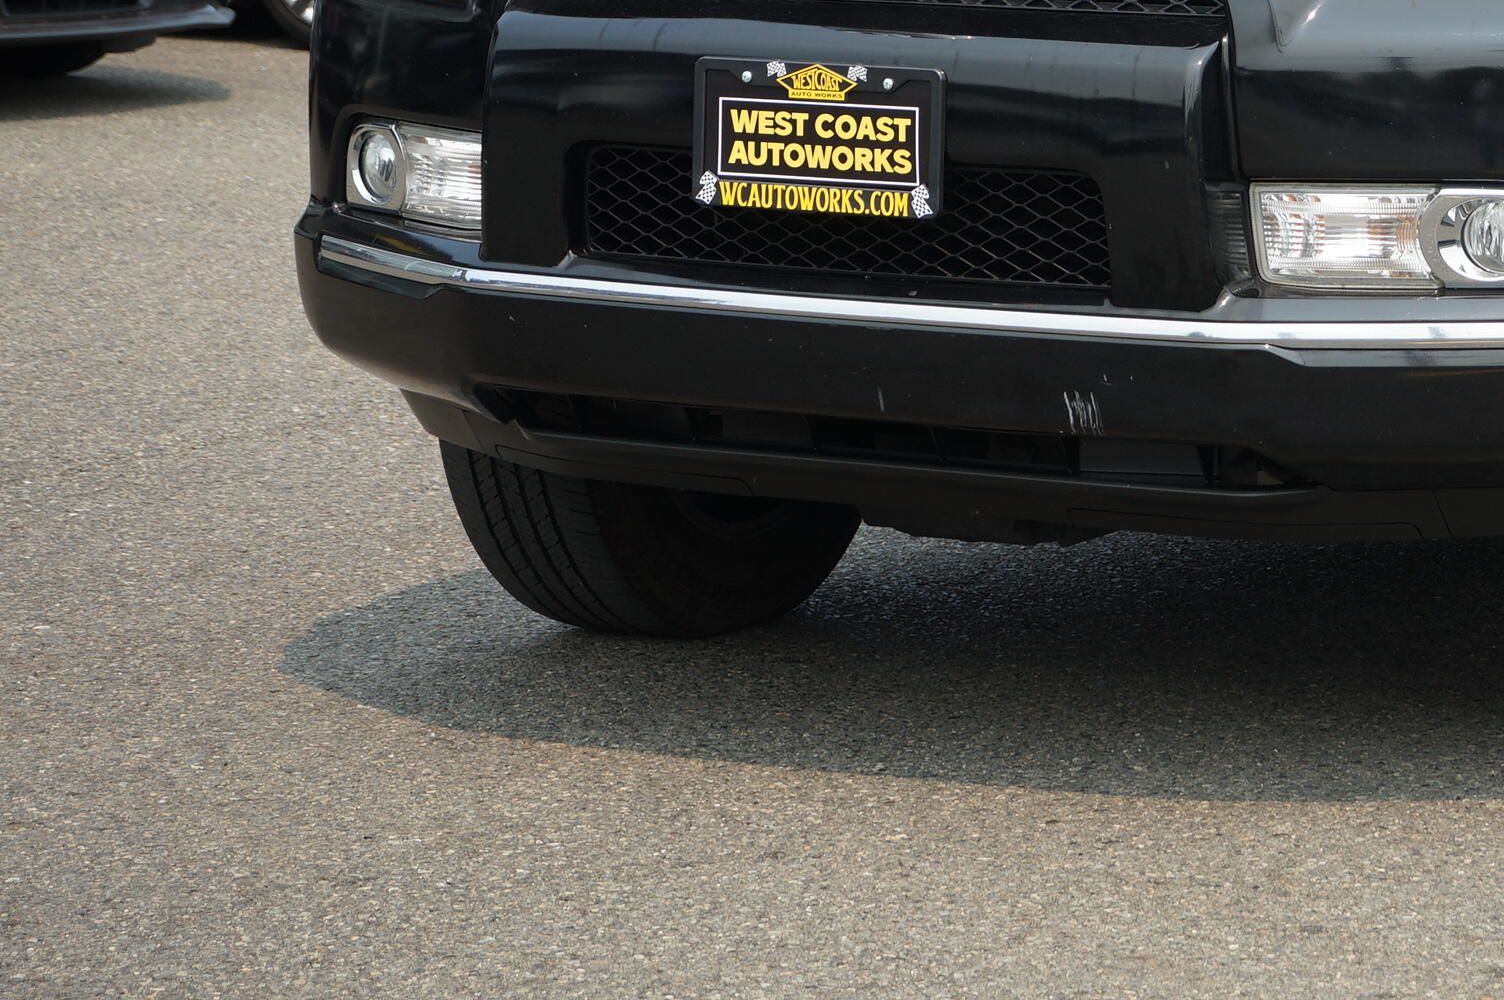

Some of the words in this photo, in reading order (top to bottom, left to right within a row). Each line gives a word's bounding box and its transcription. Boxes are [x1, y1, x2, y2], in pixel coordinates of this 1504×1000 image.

[730, 108, 809, 137] WEST
[814, 113, 912, 143] COAST
[727, 140, 913, 175] AUTOWORKS
[719, 181, 909, 217] WCAUTOWORKS.COM
